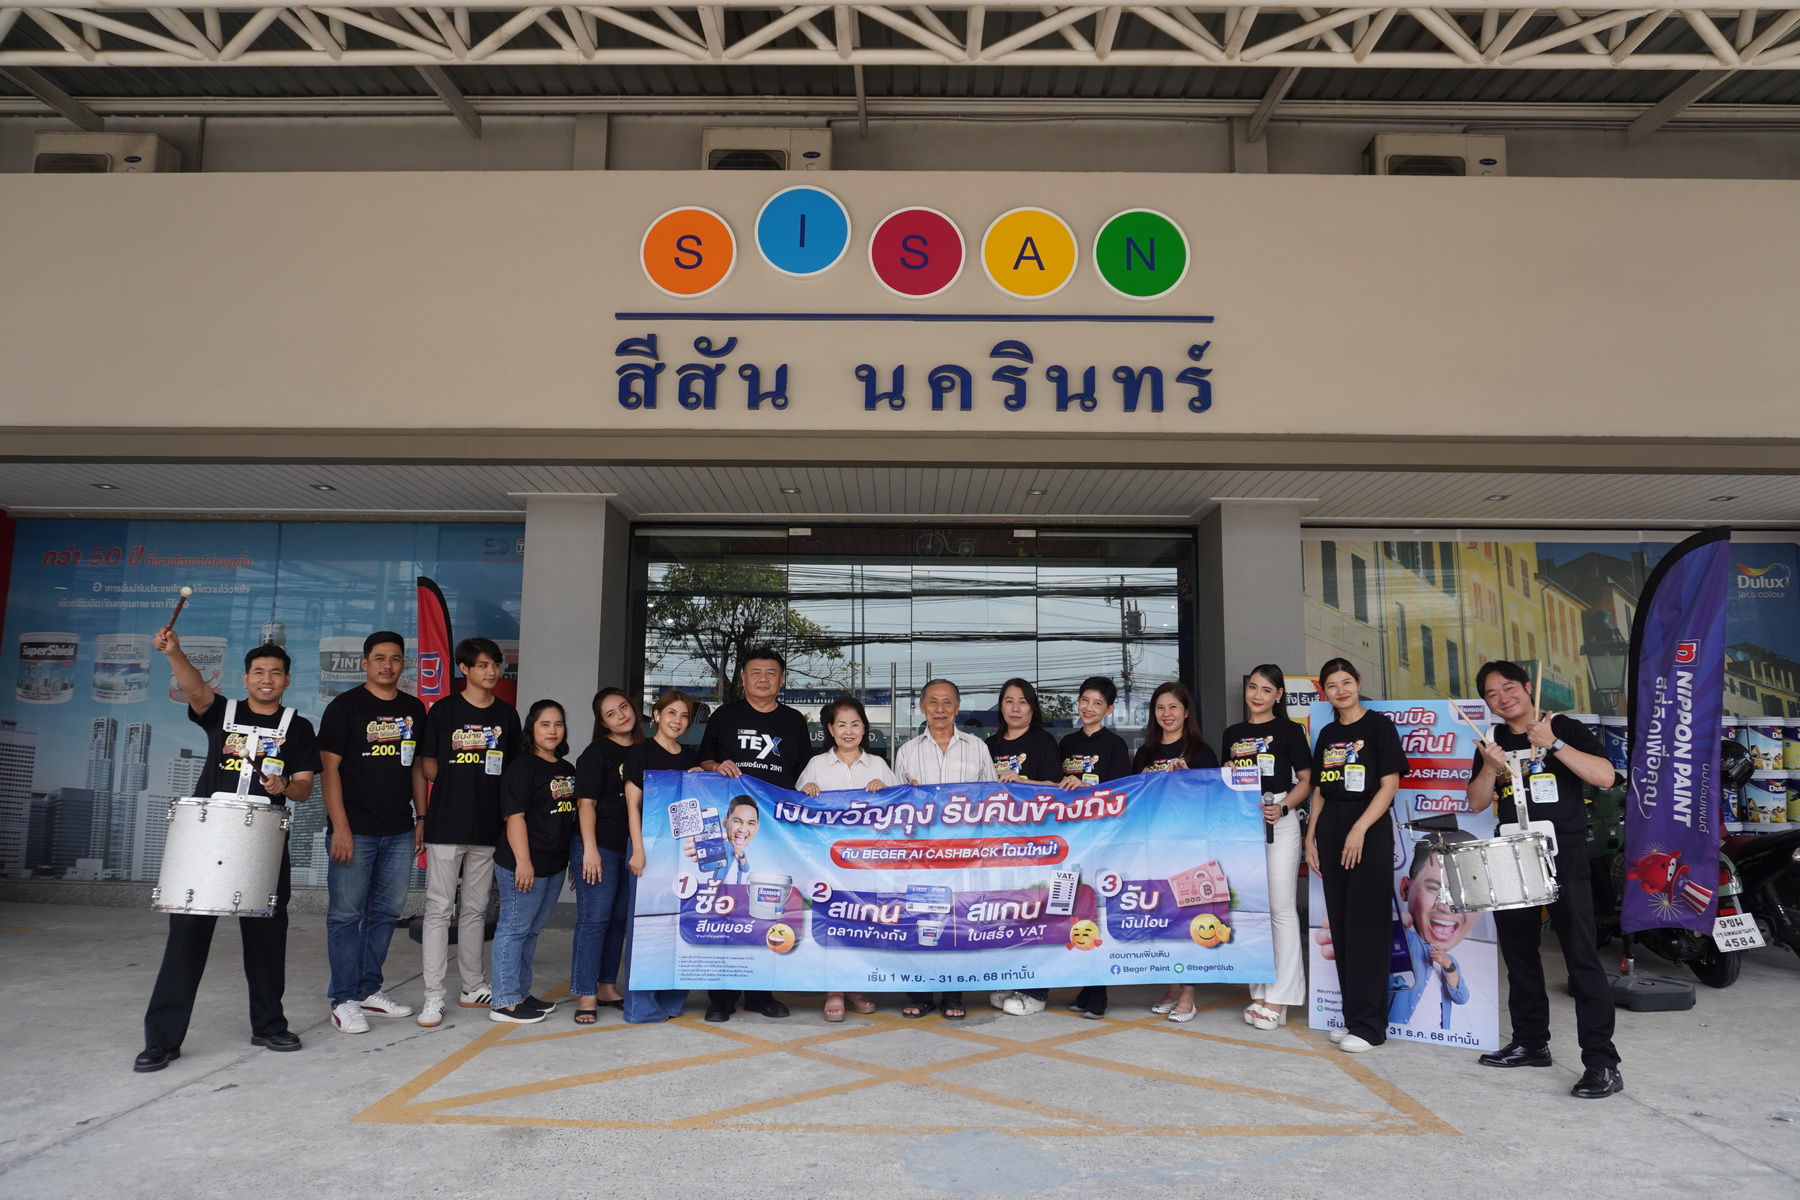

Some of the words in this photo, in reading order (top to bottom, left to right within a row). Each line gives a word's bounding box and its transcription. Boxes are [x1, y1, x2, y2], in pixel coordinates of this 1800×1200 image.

[615, 333, 789, 411] สีสัน
[854, 340, 1214, 414] นครินทร์
[41, 544, 81, 566] กว่า
[89, 547, 122, 566] 50
[127, 545, 145, 566] ปี
[1737, 575, 1785, 589] Dulux
[1738, 590, 1756, 598] let's
[1758, 590, 1785, 598] colour
[22, 645, 75, 657] SuperShield
[331, 657, 361, 672] 7IN1
[1674, 671, 1694, 759] NIPPON
[371, 745, 396, 756] 200
[737, 734, 782, 760] TEX
[224, 758, 243, 772] 20
[456, 752, 480, 764] 200
[1320, 770, 1341, 782] 200
[1673, 762, 1692, 828] PAINT
[557, 801, 572, 812] 200
[941, 789, 1126, 825] รับคืนข้างถัง
[841, 848, 860, 859] กับ
[861, 849, 906, 859] BEGER
[909, 849, 923, 859] AI
[929, 848, 999, 859] CASHBACK
[1001, 841, 1059, 857] โฉมใหม่!
[1056, 872, 1074, 880] VAT.
[1102, 874, 1118, 892] 3
[679, 876, 689, 894] 1
[812, 882, 828, 898] 2
[695, 879, 735, 914] ซื้อ
[1120, 885, 1159, 911] รับ
[828, 901, 901, 923] สแกน
[966, 901, 1041, 922] สแกน
[695, 920, 755, 934] สีเบเยอร์
[1121, 915, 1169, 929] เงินโอน
[827, 926, 907, 942] ฉลากข้างถัง
[968, 925, 1015, 941] ใบเสร็จ
[1019, 924, 1048, 937] VAT
[1725, 936, 1756, 948] 4584
[1109, 948, 1170, 959] สอบถามเพิ่มเติม
[867, 967, 886, 982] เริ่ม
[890, 973, 896, 982] 1
[900, 973, 926, 983] พ.ย.
[938, 974, 952, 983] 31
[956, 975, 980, 983] ธ.ค.
[983, 972, 998, 981] 68
[1001, 965, 1036, 981] เท่านั้น
[1122, 965, 1148, 974] Beger
[1149, 964, 1170, 973] Paint
[1186, 963, 1234, 972] @begerclub
[1389, 1027, 1402, 1036] 31
[1405, 1030, 1428, 1040] ธ.ค.
[1430, 1032, 1444, 1042] 68
[1447, 1032, 1480, 1046] เท่านั้น
